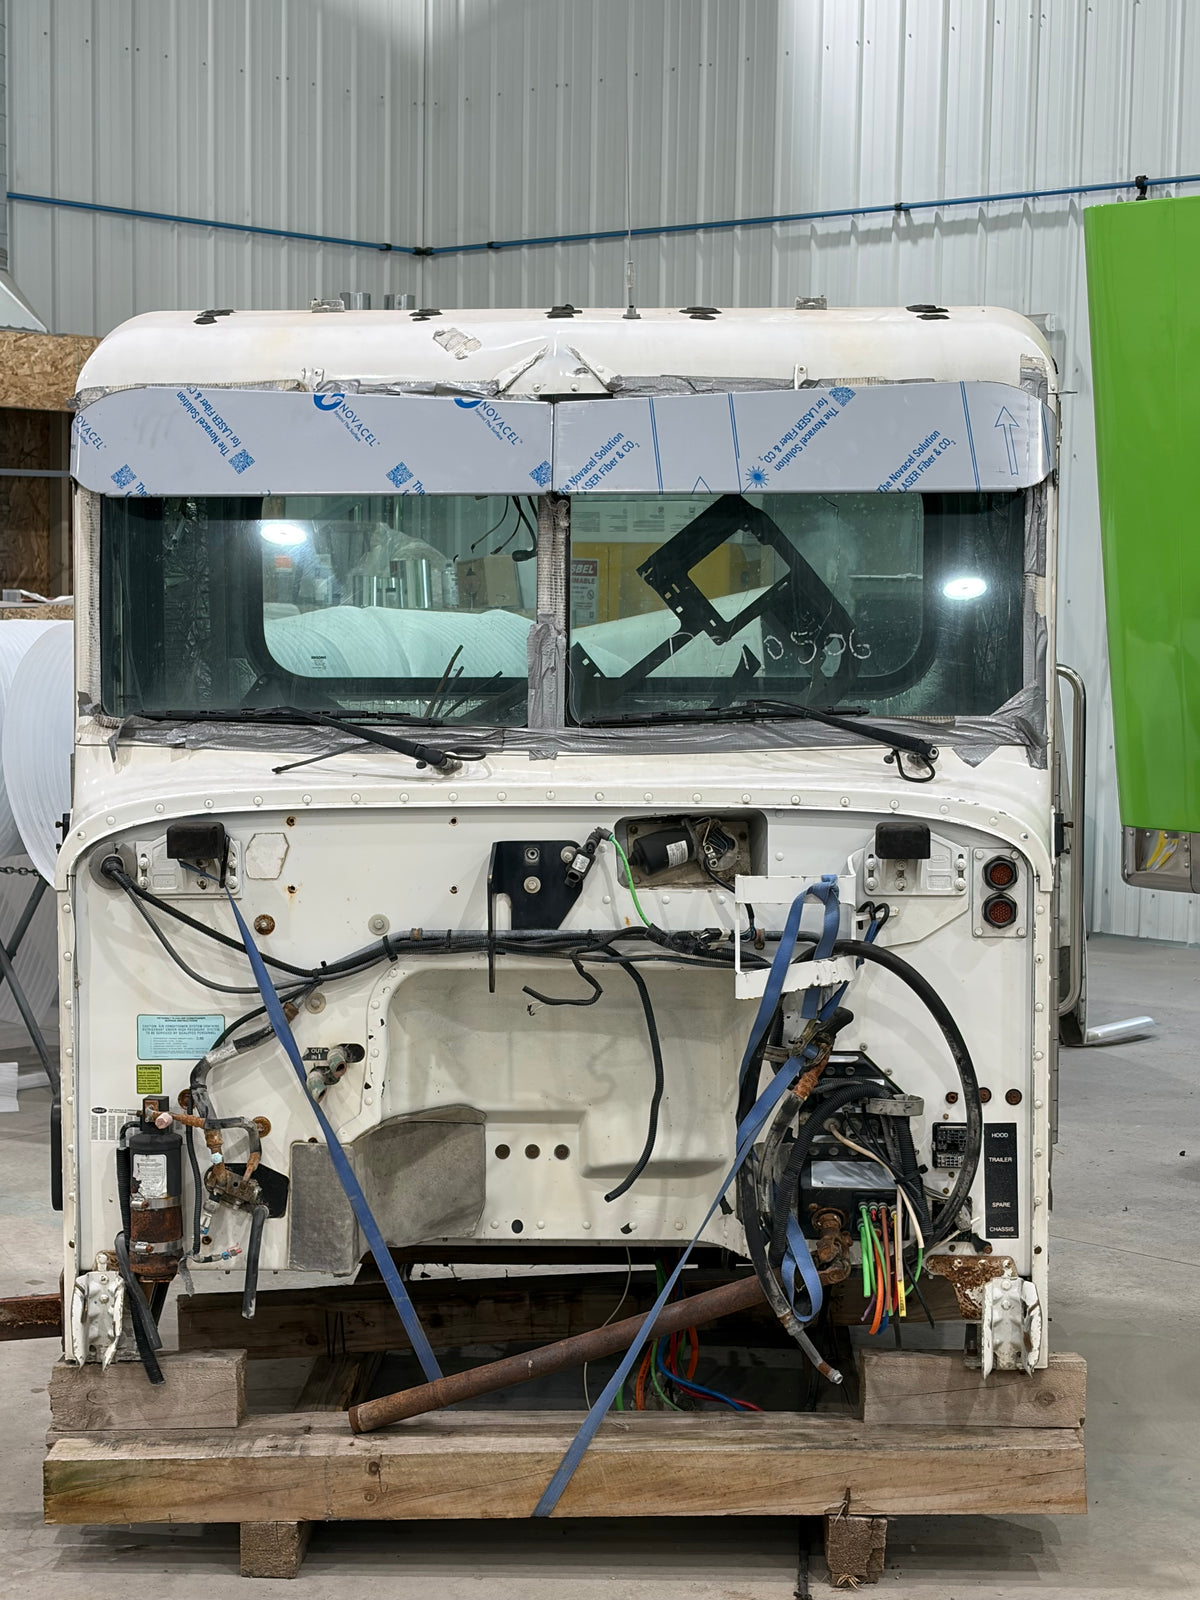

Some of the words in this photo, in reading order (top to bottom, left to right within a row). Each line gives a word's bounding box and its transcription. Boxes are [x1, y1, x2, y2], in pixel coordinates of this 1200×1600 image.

[176, 391, 200, 420] Solution
[194, 391, 203, 400] &
[199, 398, 216, 418] Fiber
[816, 397, 829, 410] for
[211, 413, 234, 439] LASER
[338, 402, 377, 447] NOVACEL
[478, 401, 519, 446] NOVACEL
[794, 407, 819, 432] LASER
[822, 407, 839, 421] The
[75, 415, 102, 450] OVACEL
[196, 416, 221, 445] Novacel
[230, 435, 241, 448] for
[779, 428, 799, 448] Fiber
[799, 418, 828, 447] Novacel
[216, 441, 229, 457] The
[567, 457, 598, 486] Novacel
[593, 432, 624, 461] Solution
[772, 444, 782, 453] &
[774, 443, 804, 472] Solution
[888, 454, 917, 483] Novacel
[912, 430, 941, 458] Solution
[916, 454, 936, 473] Fiber
[932, 448, 943, 456] &
[598, 456, 619, 476] Fiber
[615, 450, 626, 460] &
[991, 1201, 1012, 1209] SPARE
